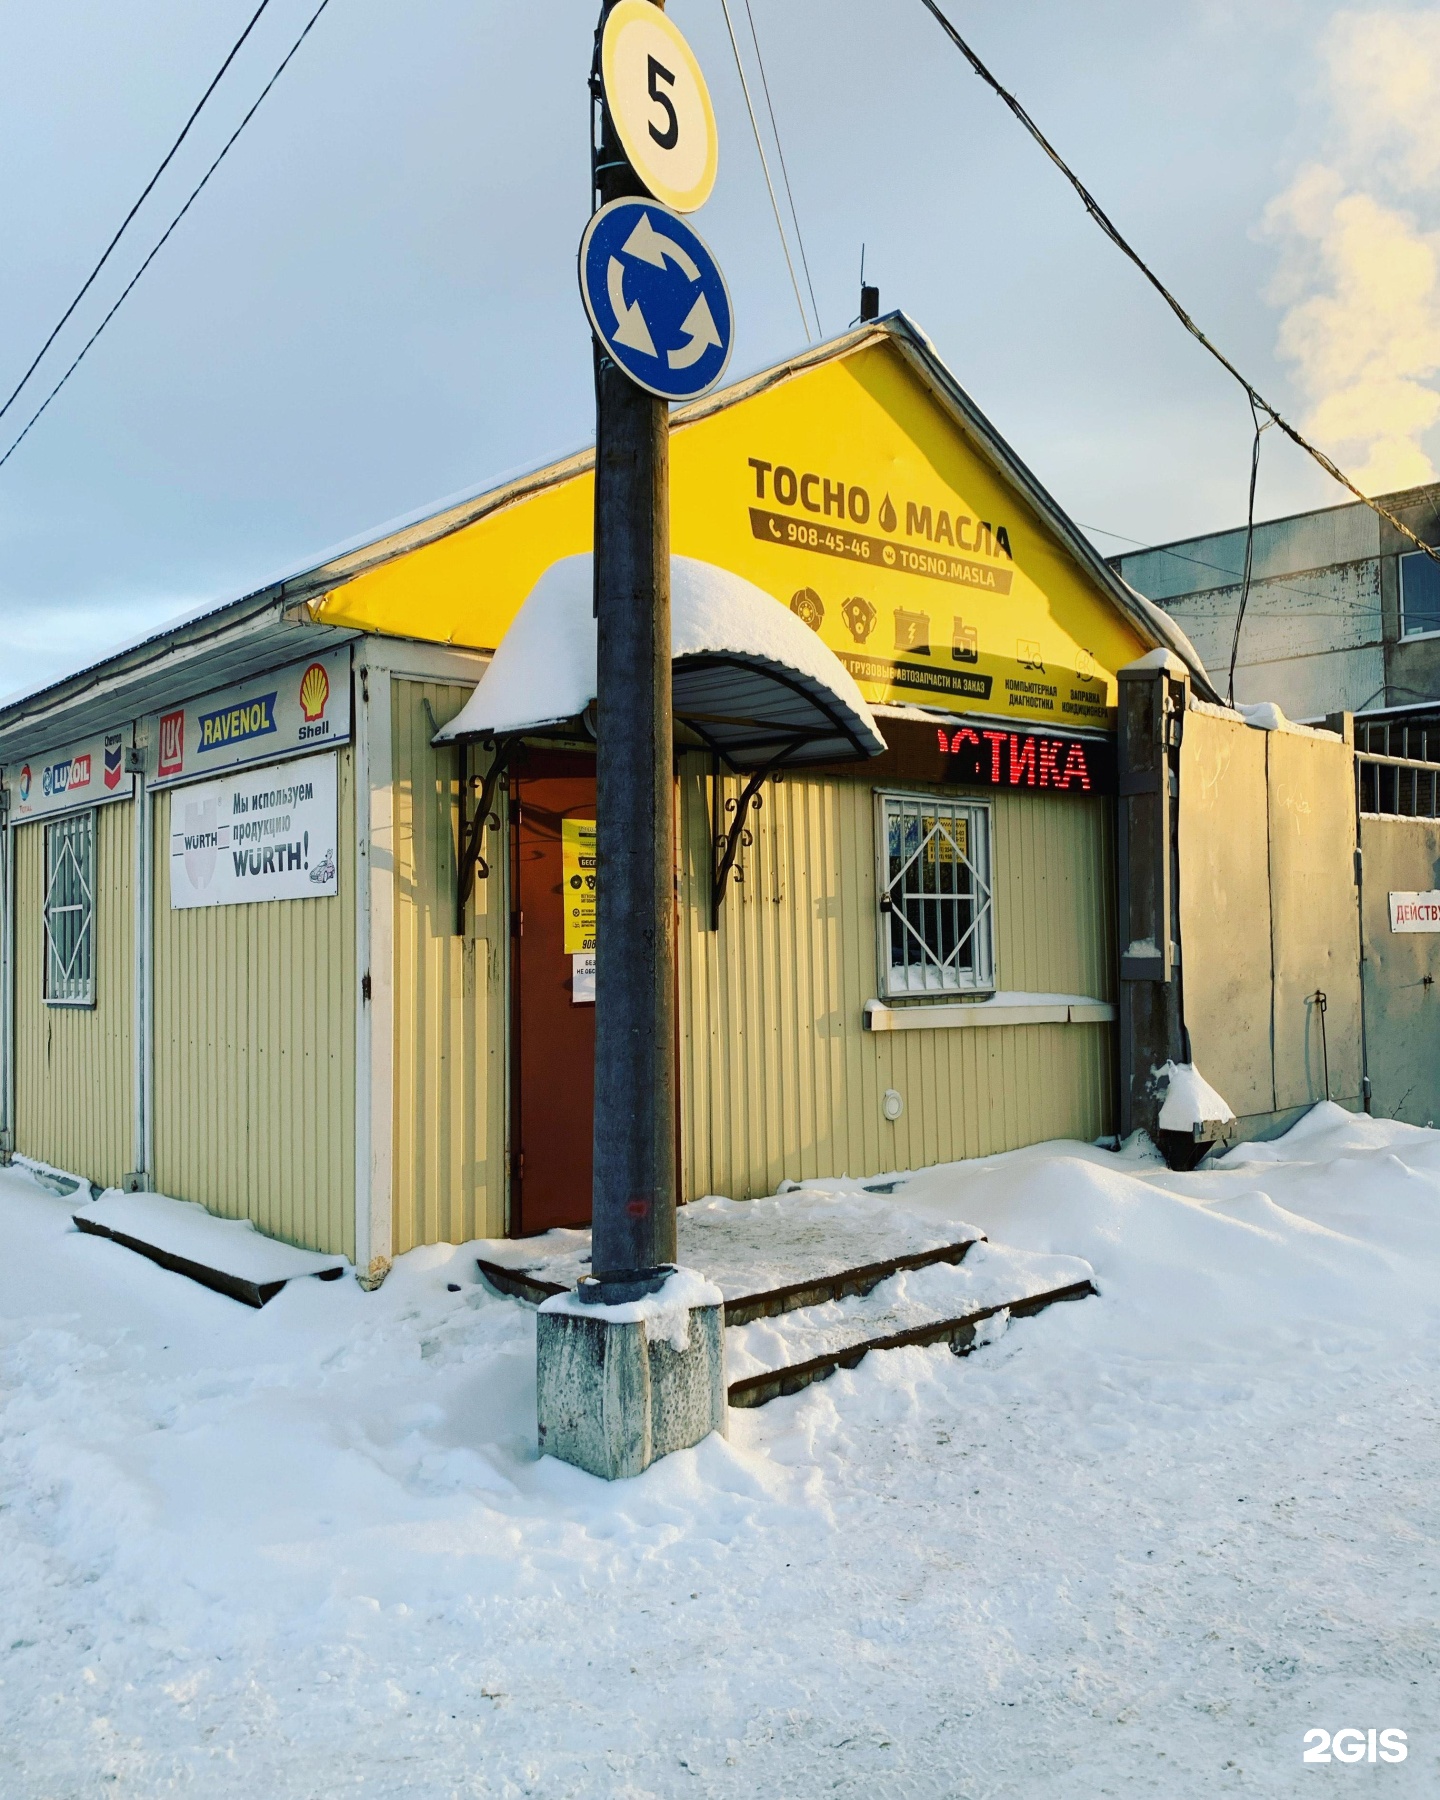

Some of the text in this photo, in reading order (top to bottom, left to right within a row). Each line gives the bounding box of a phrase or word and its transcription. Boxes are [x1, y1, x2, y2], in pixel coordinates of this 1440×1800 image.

[647, 54, 679, 150] 5
[748, 457, 1013, 561] ТОСНО МАСЛА
[787, 523, 870, 558] 908-45-46
[900, 550, 996, 587] TOSNO.MASLA
[850, 660, 894, 679] ГРУЗОВЫЕ
[896, 668, 951, 688] АВТОЗАПЧАСТИ
[952, 678, 962, 690] НА
[963, 680, 985, 693] ЗАКАЗ
[1005, 679, 1058, 697] КОМПЬЮТЕРНАЯ
[1009, 694, 1054, 710] ДИАГНОСТИКА
[203, 701, 270, 746] RAVENOL
[298, 720, 330, 741] Shell
[104, 733, 122, 747] Chevron
[233, 782, 314, 815] Мы используем
[184, 831, 218, 851] WÜRTH
[233, 814, 291, 846] продукцию
[232, 830, 309, 877] WÜRTH!
[1396, 902, 1440, 925] ДЕЙСТВ
